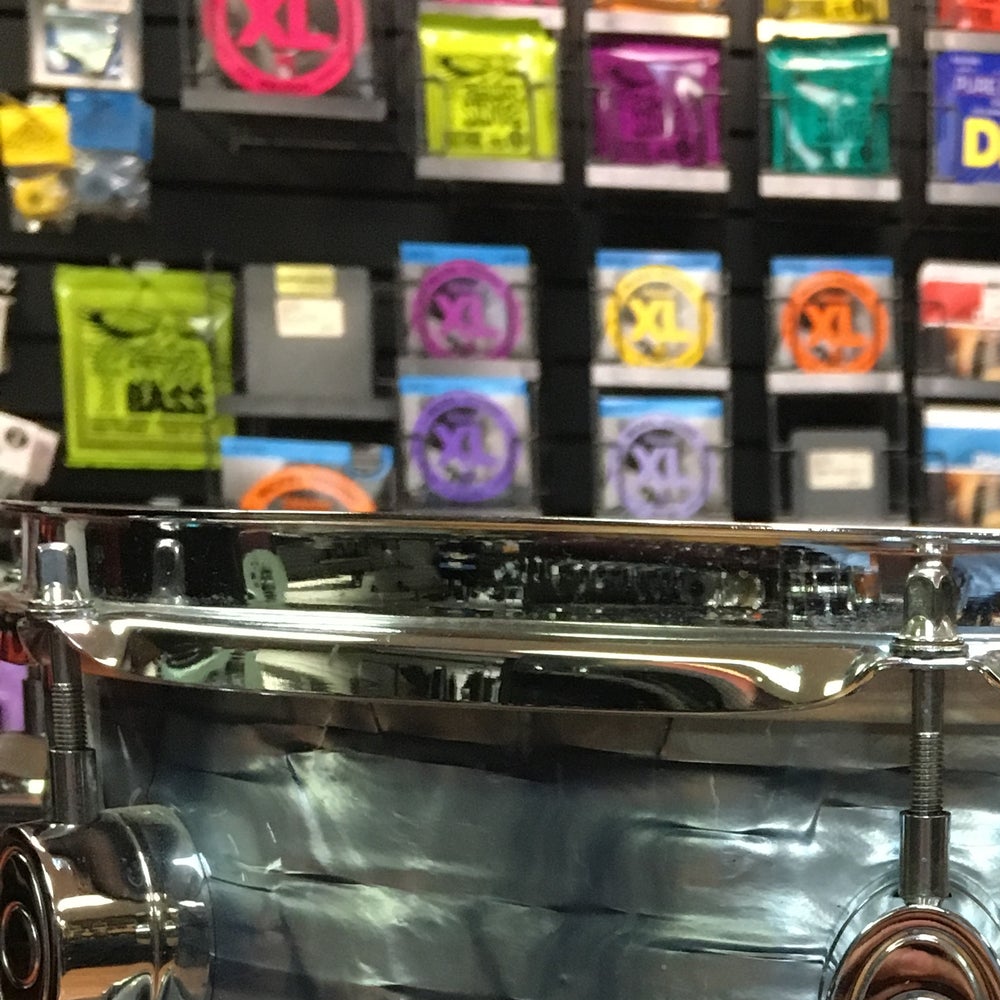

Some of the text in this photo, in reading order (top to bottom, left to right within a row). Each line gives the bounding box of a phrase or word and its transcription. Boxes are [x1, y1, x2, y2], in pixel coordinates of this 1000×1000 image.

[237, 0, 336, 50] XL
[434, 294, 500, 338] XL
[628, 299, 692, 342] XL
[804, 304, 867, 347] XL
[432, 425, 496, 468] XL
[630, 447, 694, 488] XL
